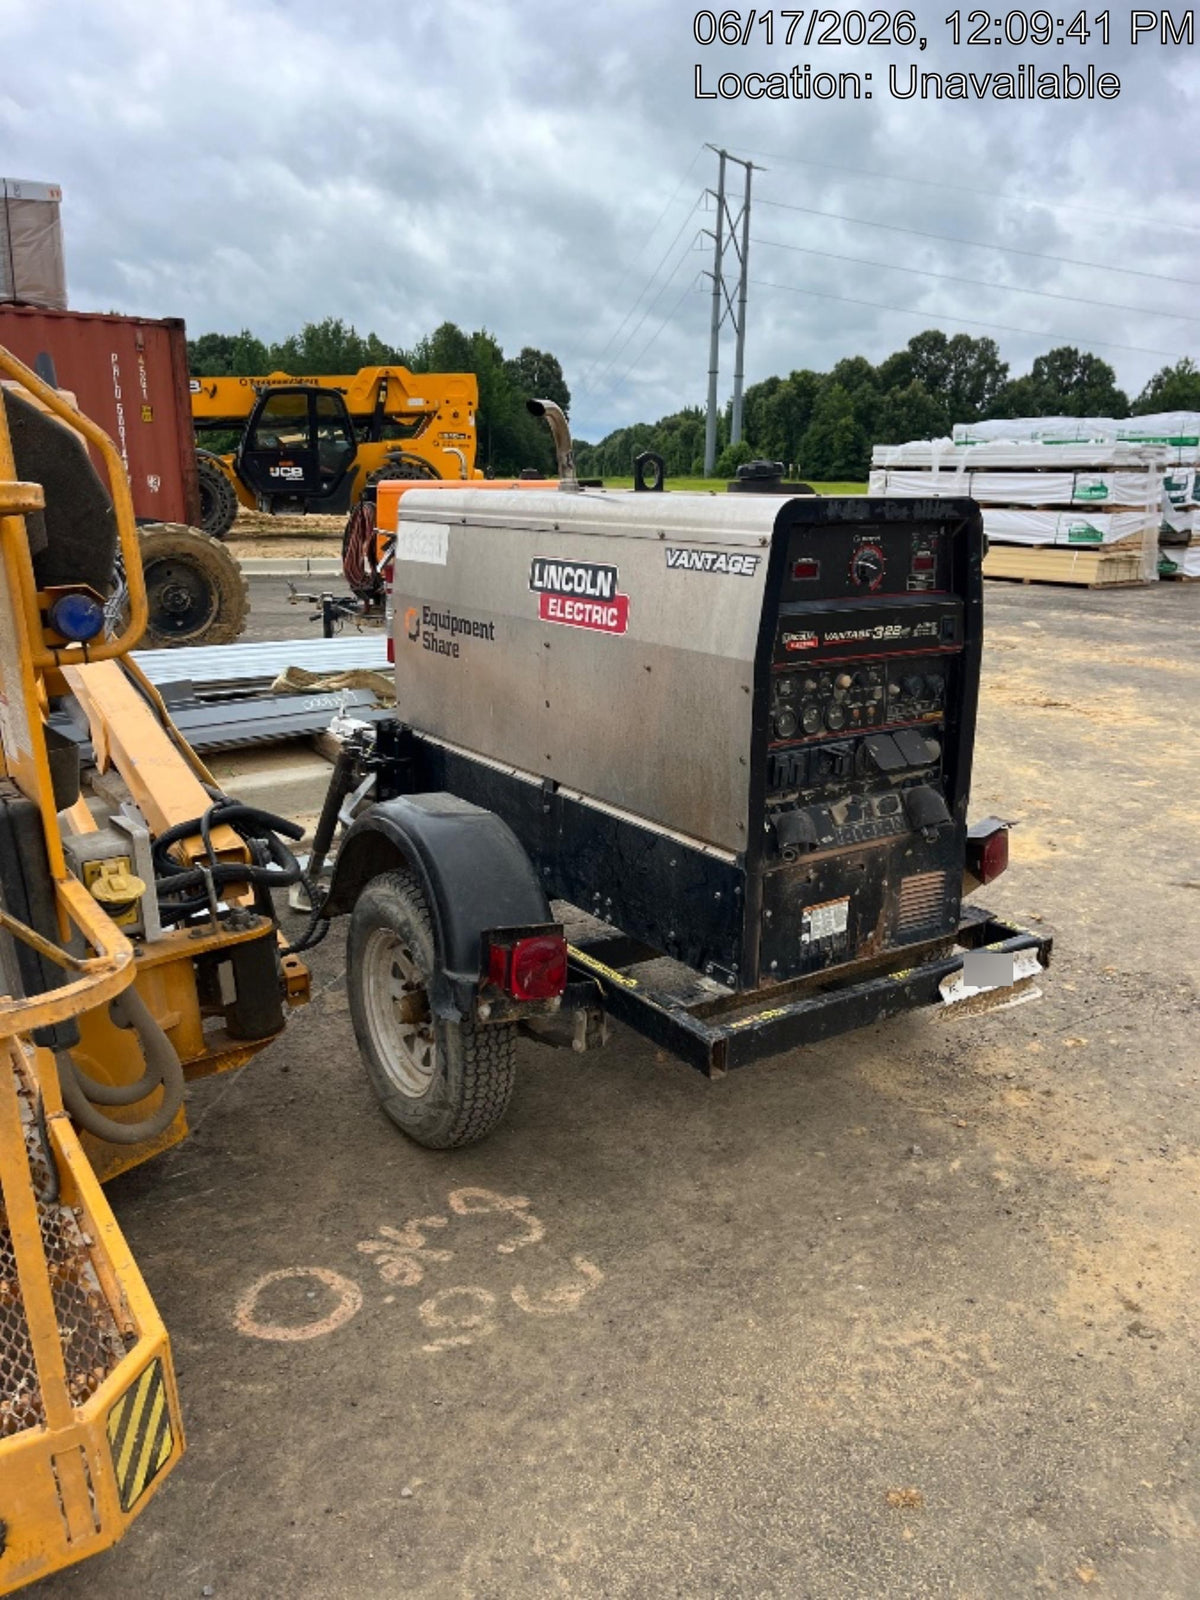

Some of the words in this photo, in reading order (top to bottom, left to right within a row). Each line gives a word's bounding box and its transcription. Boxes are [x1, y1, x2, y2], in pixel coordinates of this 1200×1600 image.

[269, 467, 303, 477] JCB
[666, 549, 757, 575] VANTAGE
[533, 563, 612, 598] LINCOLN
[422, 606, 494, 640] Equipment
[548, 598, 618, 626] ELECTRIC
[422, 631, 460, 658] Share
